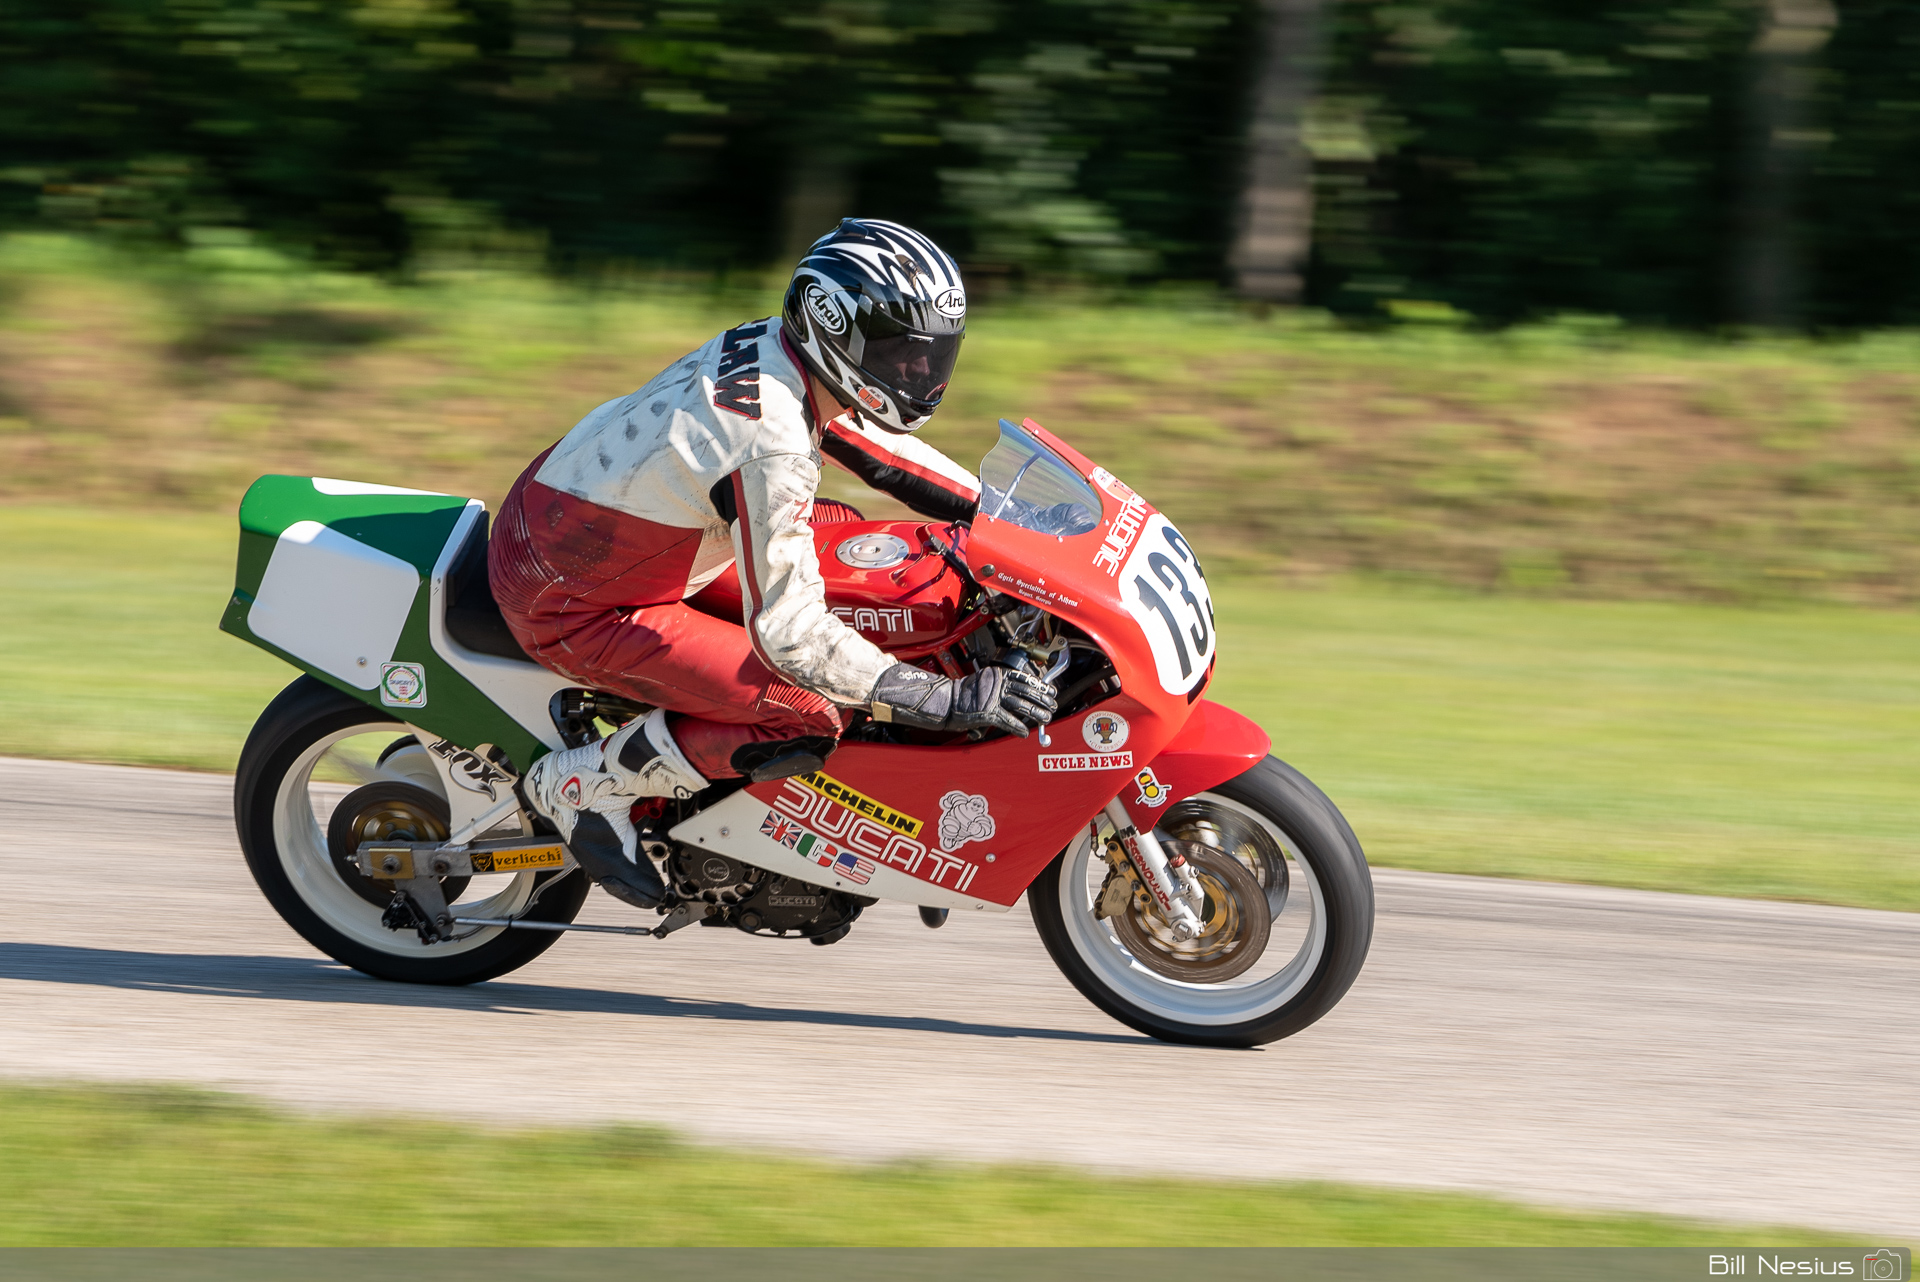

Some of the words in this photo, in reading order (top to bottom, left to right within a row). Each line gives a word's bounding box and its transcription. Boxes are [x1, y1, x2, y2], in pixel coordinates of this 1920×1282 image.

[807, 293, 842, 326] Arai
[939, 292, 965, 308] Ara
[713, 316, 769, 420] LAW
[1092, 500, 1147, 578] DUCAT
[997, 572, 1014, 584] Cycle
[1057, 594, 1079, 607] Athens
[830, 606, 914, 633] CATI
[427, 740, 512, 795] FOX
[1042, 756, 1086, 770] CYCLE
[1089, 754, 1131, 768] NEWS
[798, 771, 917, 834] MICHELIN
[773, 776, 979, 892] DUCATI
[495, 847, 562, 866] verlicchi
